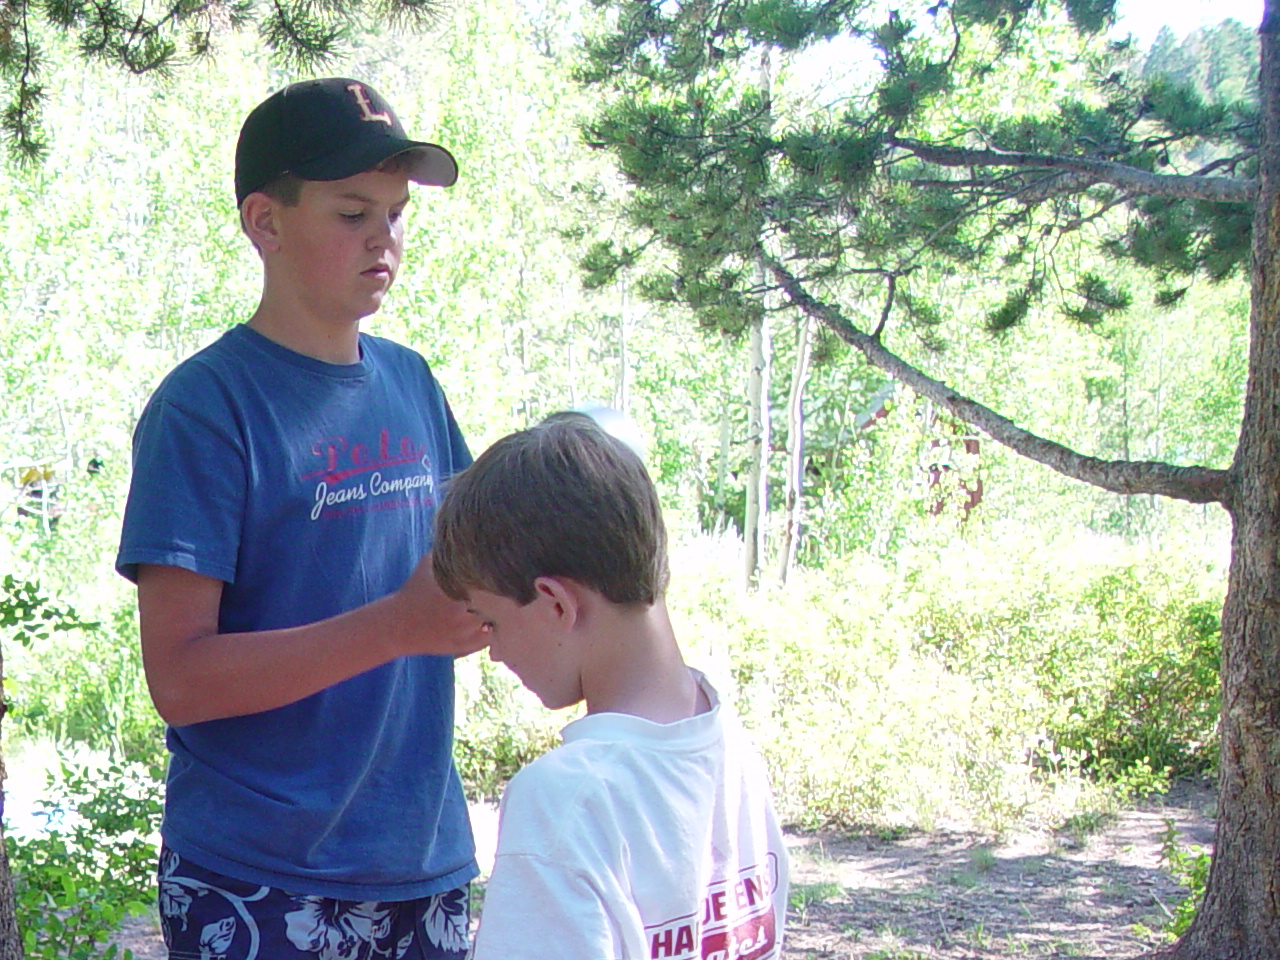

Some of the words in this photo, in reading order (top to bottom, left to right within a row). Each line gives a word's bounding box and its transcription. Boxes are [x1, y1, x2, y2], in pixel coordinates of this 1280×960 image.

[346, 83, 393, 127] L
[310, 481, 367, 521] Jeans
[370, 471, 434, 497] Company
